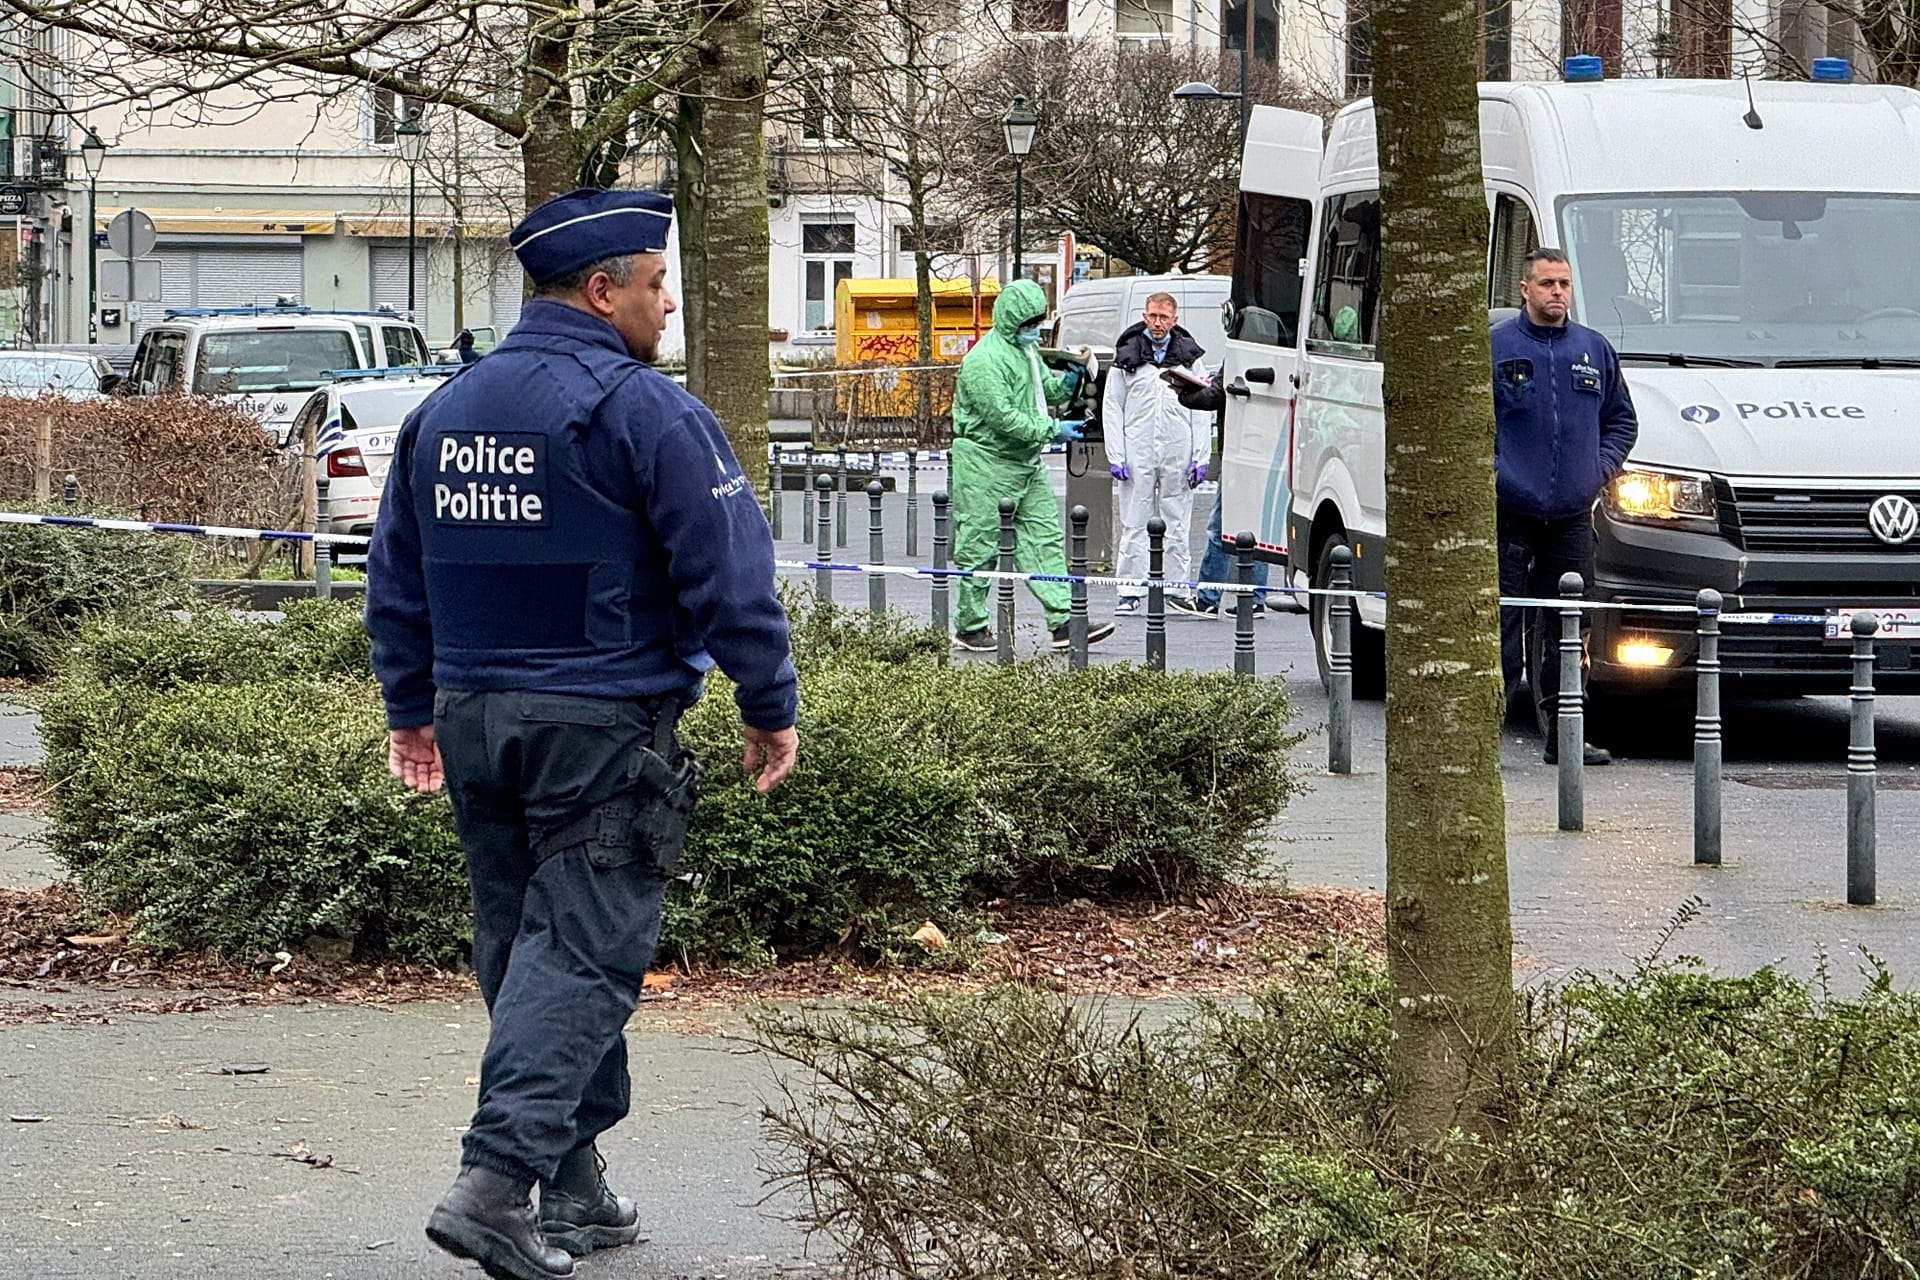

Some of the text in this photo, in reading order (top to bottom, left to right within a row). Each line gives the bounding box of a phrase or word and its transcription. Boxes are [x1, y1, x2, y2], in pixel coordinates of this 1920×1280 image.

[1736, 401, 1865, 419] Police
[439, 435, 535, 474] Police
[434, 482, 543, 521] Politie
